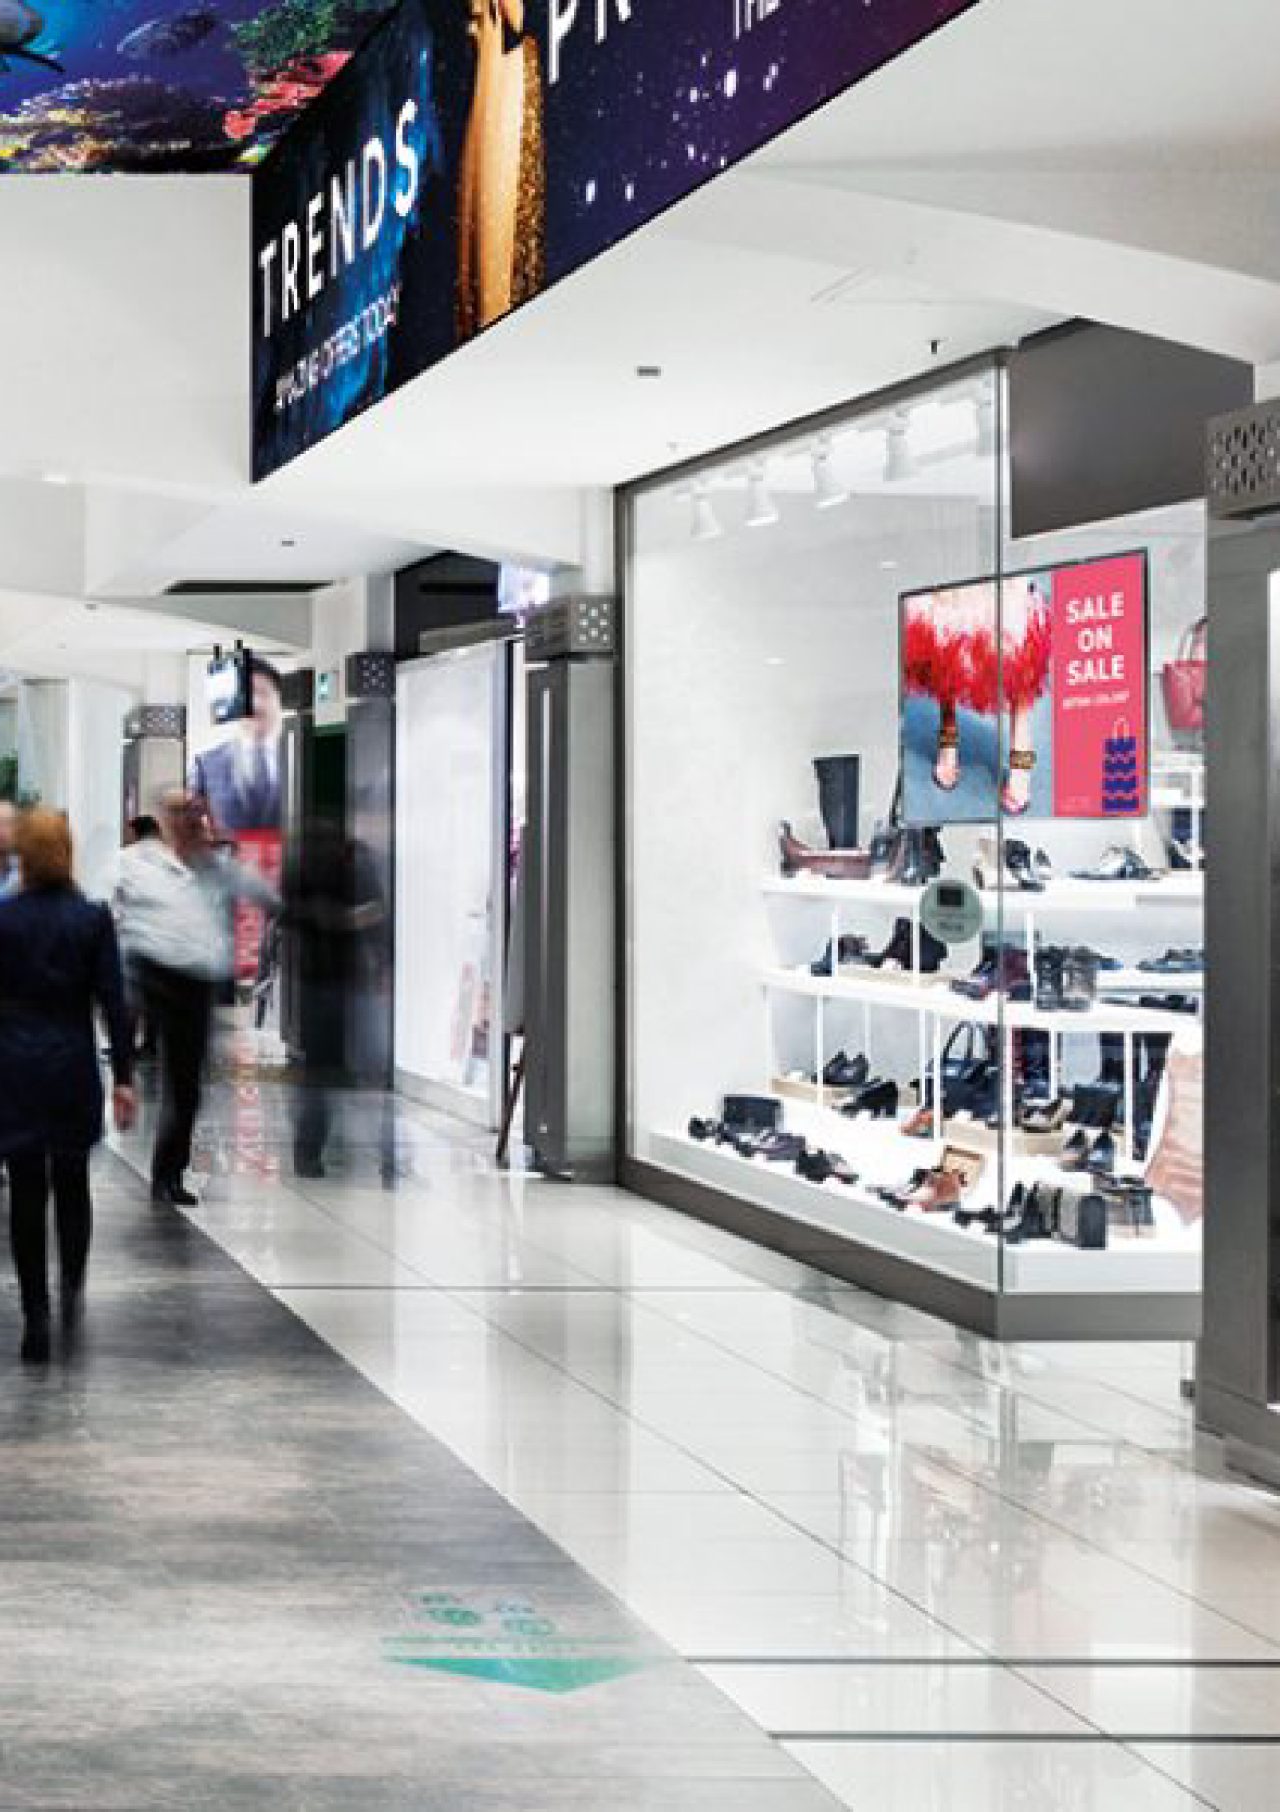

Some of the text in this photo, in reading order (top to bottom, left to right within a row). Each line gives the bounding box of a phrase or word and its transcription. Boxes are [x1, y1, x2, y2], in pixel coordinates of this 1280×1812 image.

[258, 98, 419, 338] TRENDS
[1066, 592, 1124, 625] SALE
[1078, 625, 1112, 652] ON
[1066, 655, 1124, 686] SALE
